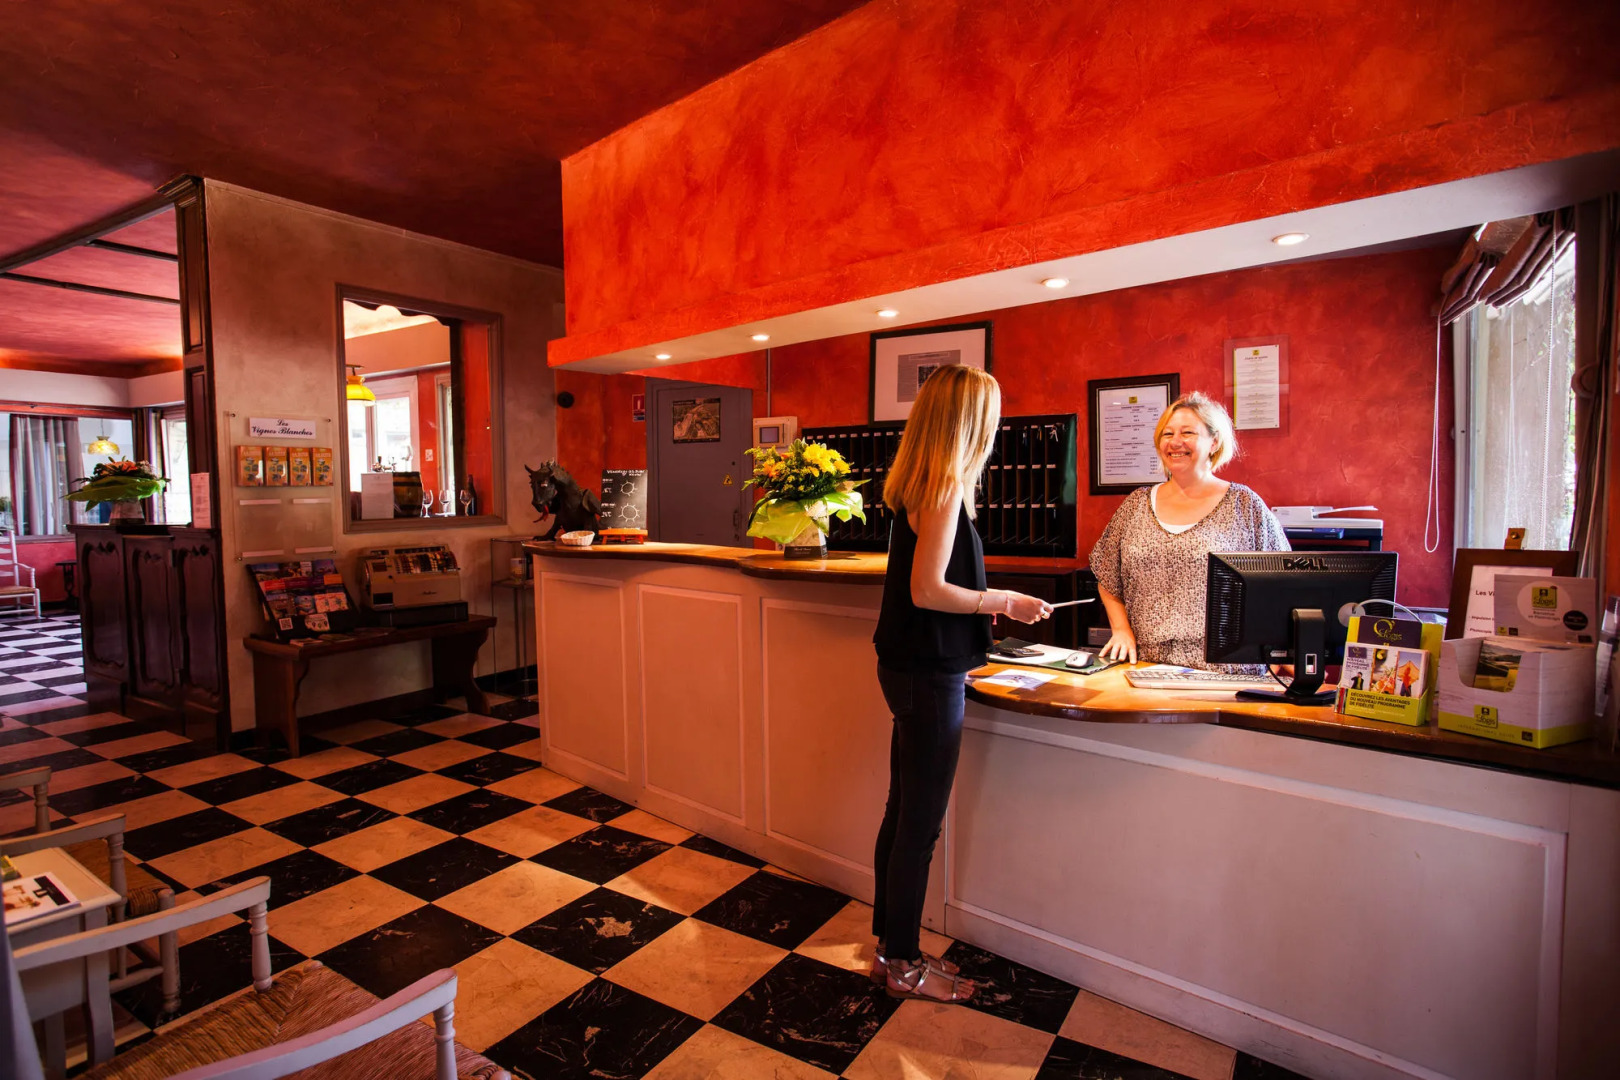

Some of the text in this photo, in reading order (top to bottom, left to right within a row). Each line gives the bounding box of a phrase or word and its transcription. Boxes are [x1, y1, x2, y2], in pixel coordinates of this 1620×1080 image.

[252, 426, 313, 436] Vignes Blanches
[1283, 557, 1329, 570] DELL
[1377, 701, 1406, 709] PROGRAMME
[1385, 697, 1411, 706] AVANTAGES
